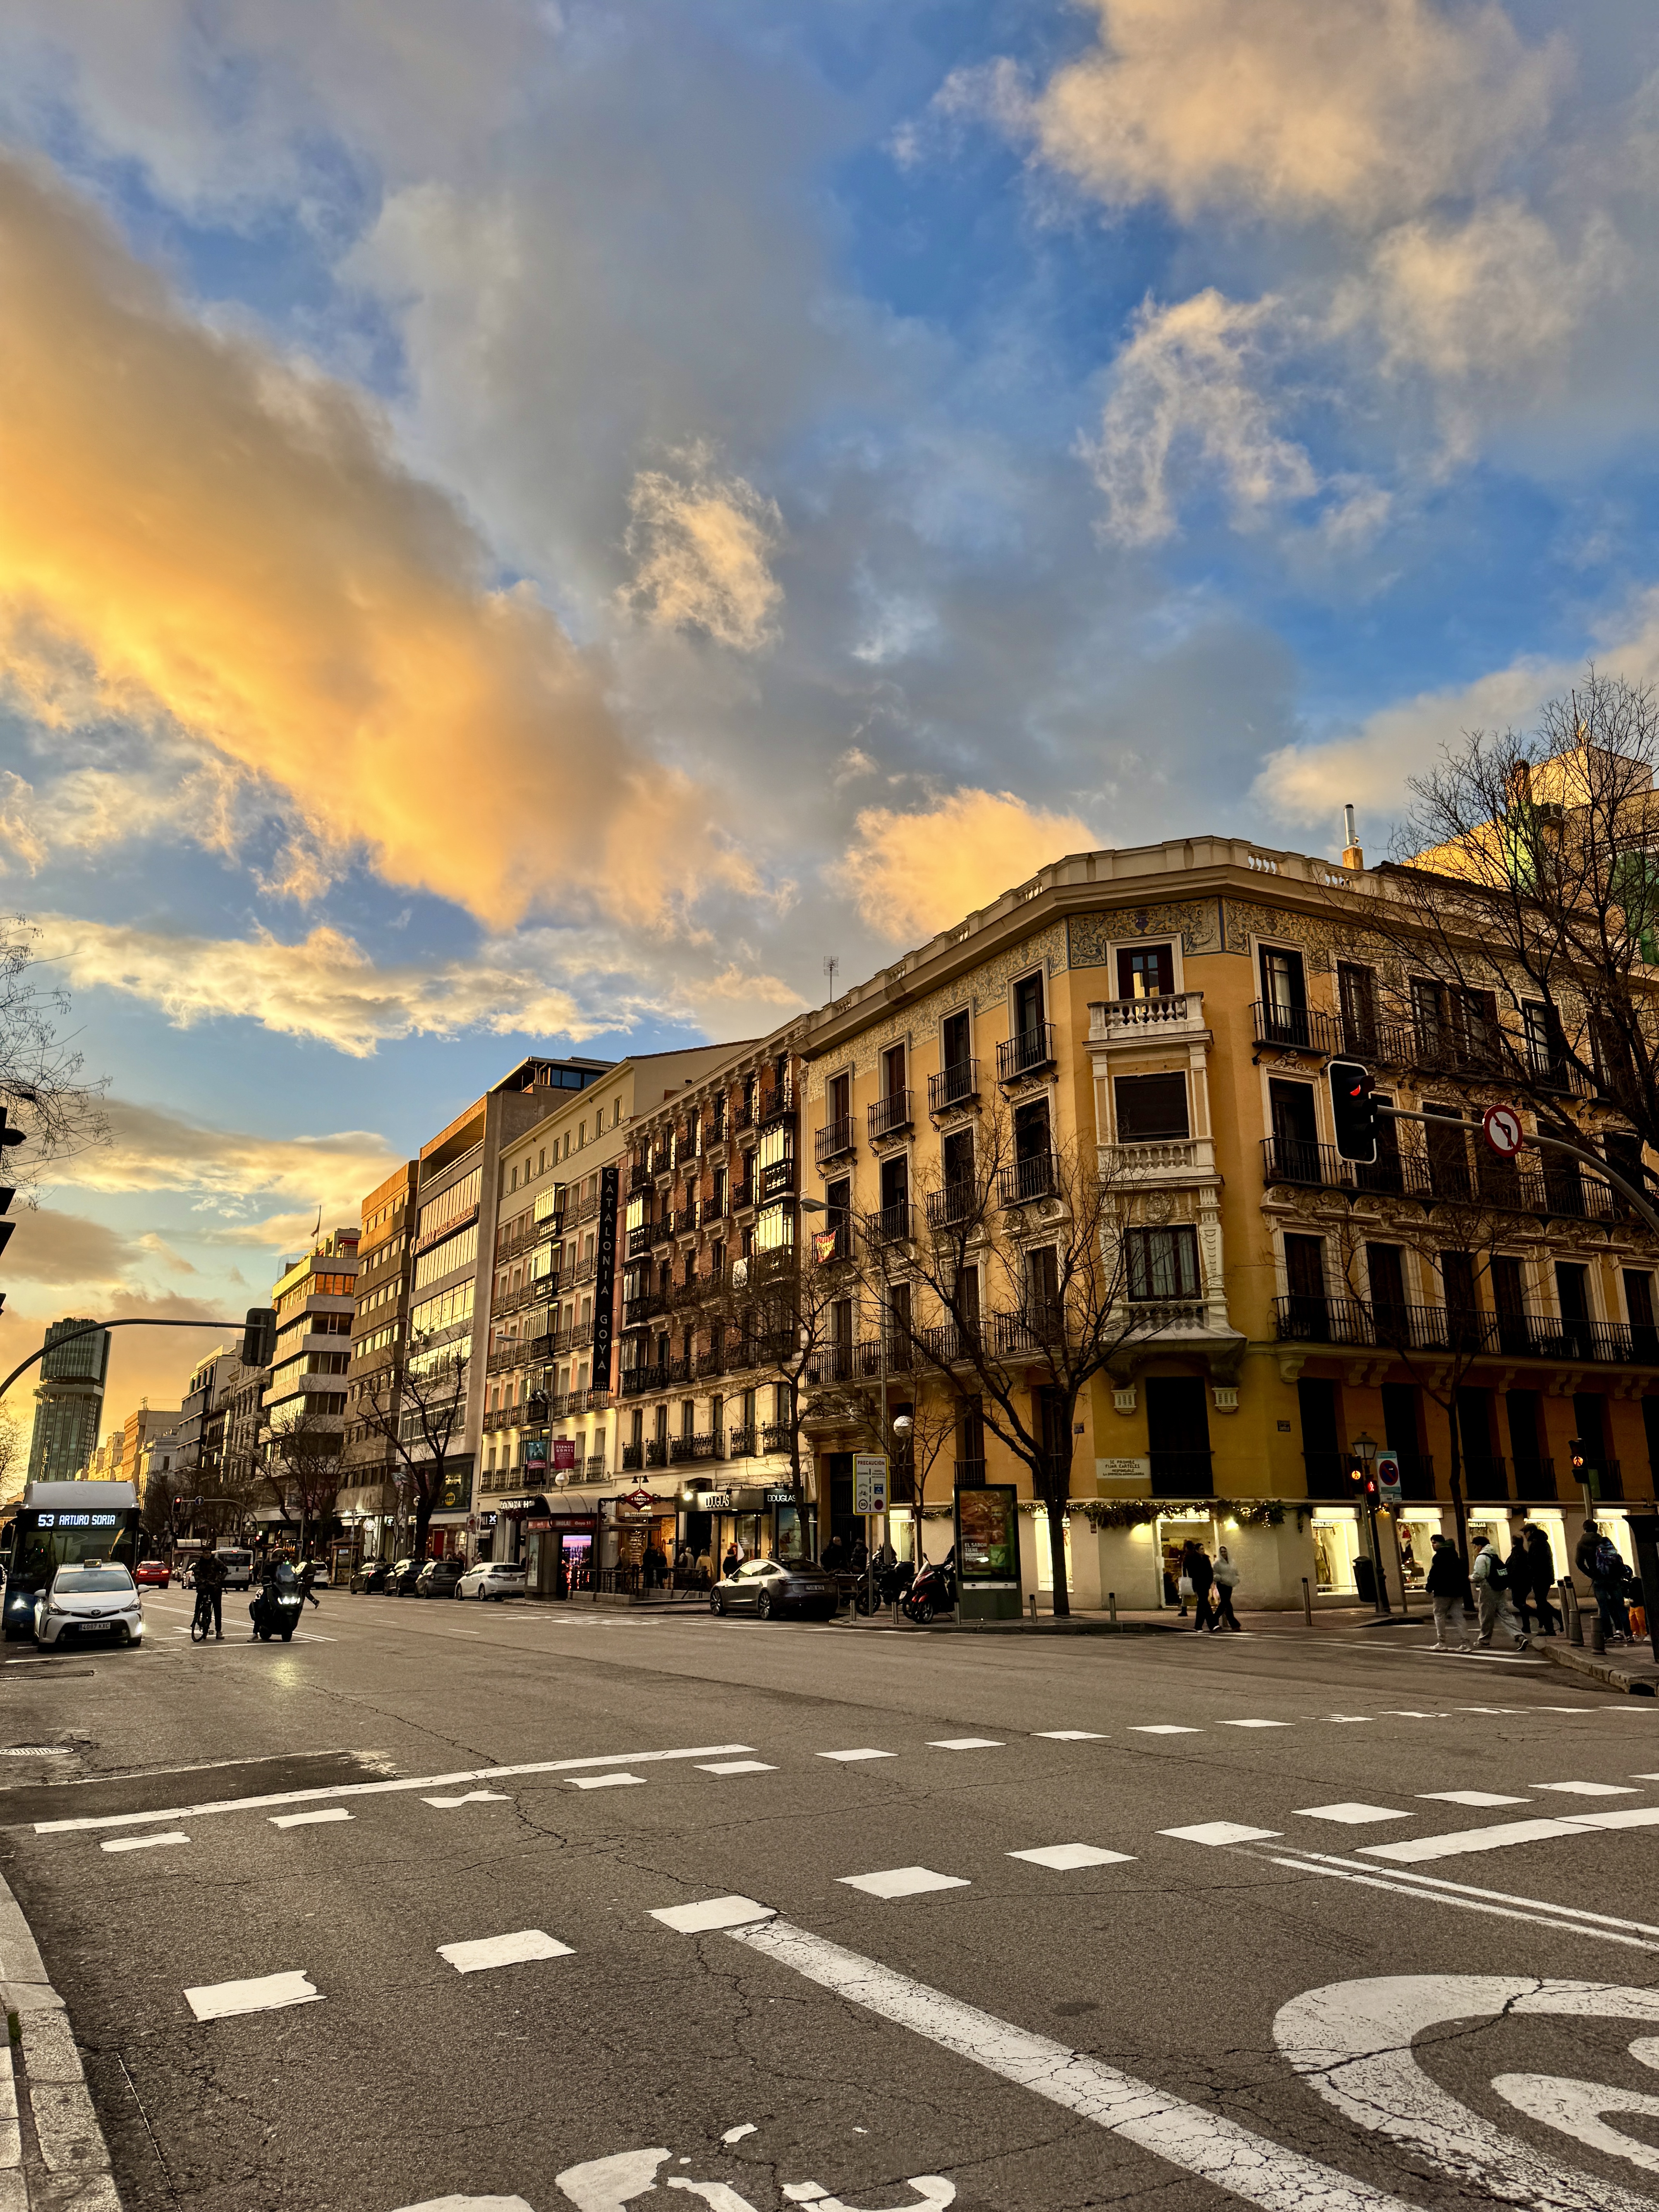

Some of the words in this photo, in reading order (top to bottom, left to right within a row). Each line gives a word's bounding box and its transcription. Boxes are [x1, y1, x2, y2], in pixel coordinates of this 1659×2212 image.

[601, 1170, 613, 1295] CATALONIA
[598, 1315, 608, 1369] GOYA
[705, 1495, 729, 1508] DOUGLAS
[38, 1515, 55, 1527] 53
[59, 1515, 89, 1525] ARTURO
[91, 1515, 115, 1525] SORIA
